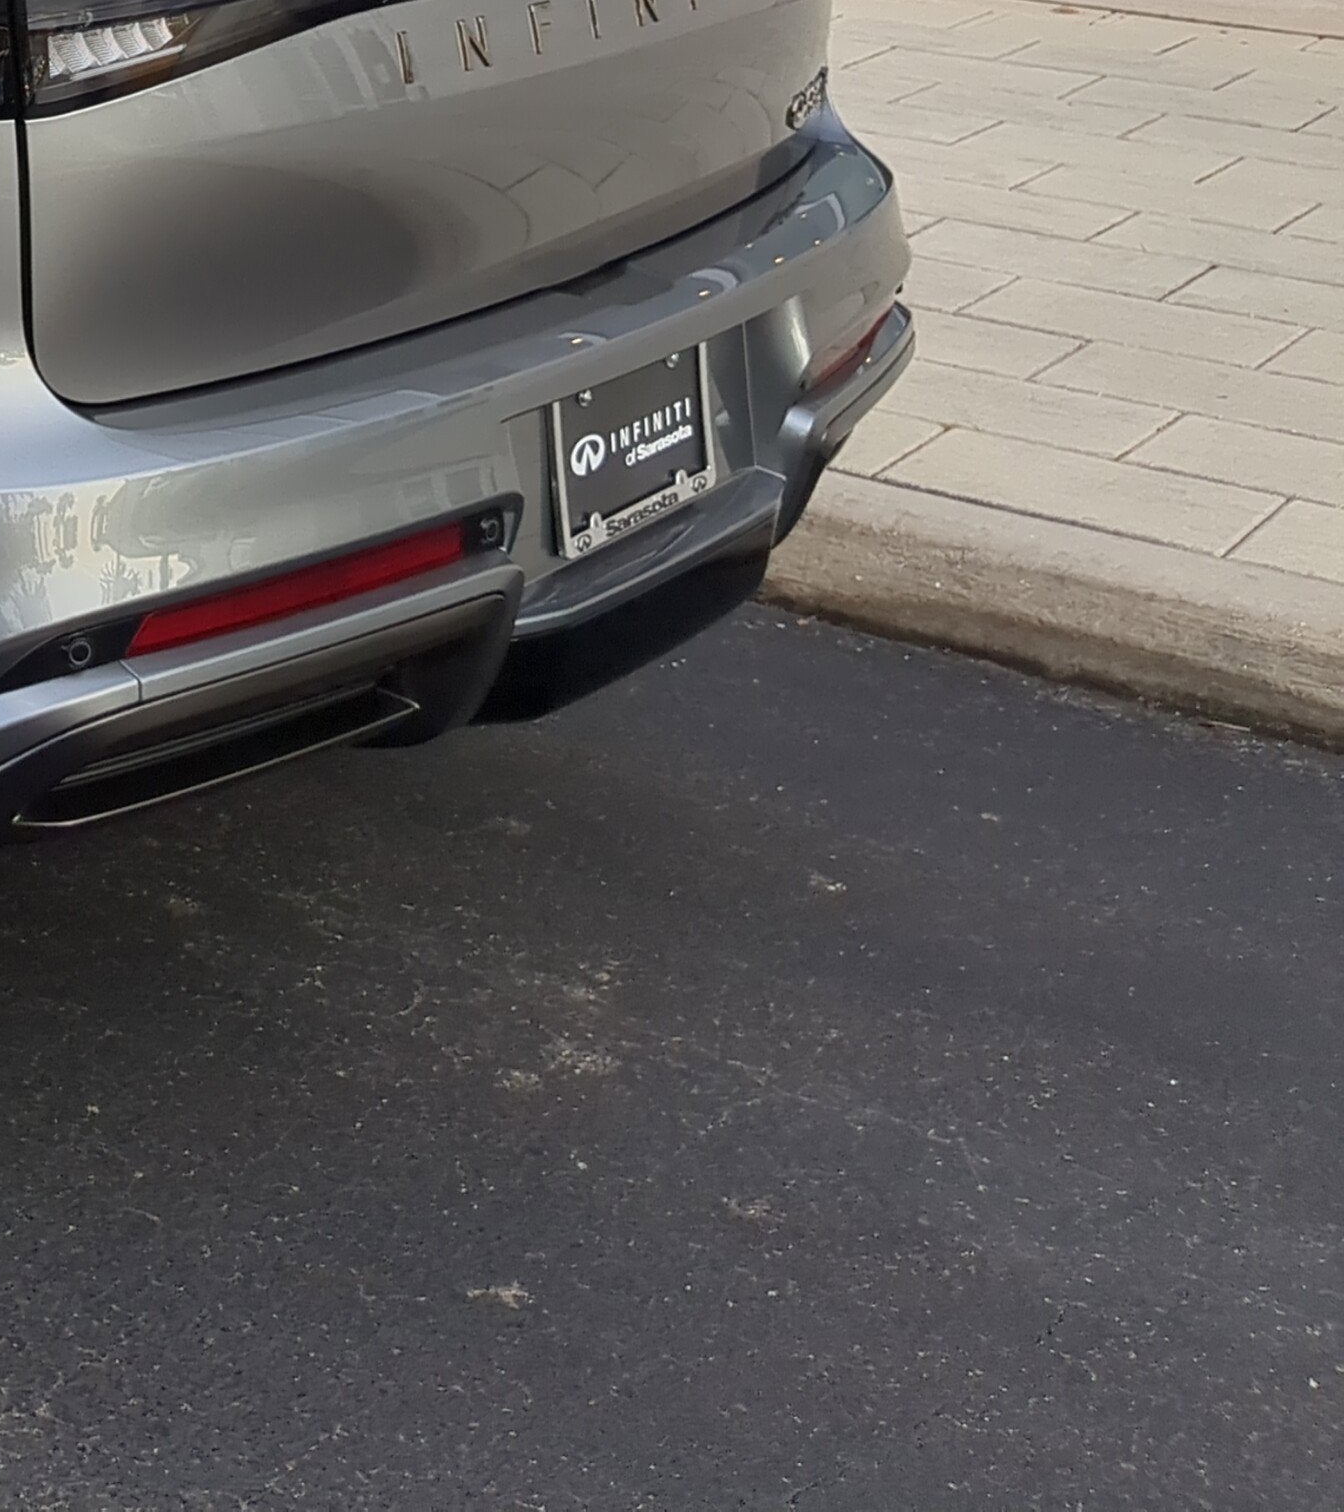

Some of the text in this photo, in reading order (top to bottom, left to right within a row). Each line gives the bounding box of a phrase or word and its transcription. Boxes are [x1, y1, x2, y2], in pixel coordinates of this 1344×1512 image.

[610, 397, 692, 453] INFINITI
[636, 424, 693, 461] Sarasota
[606, 492, 679, 537] Sarasota
